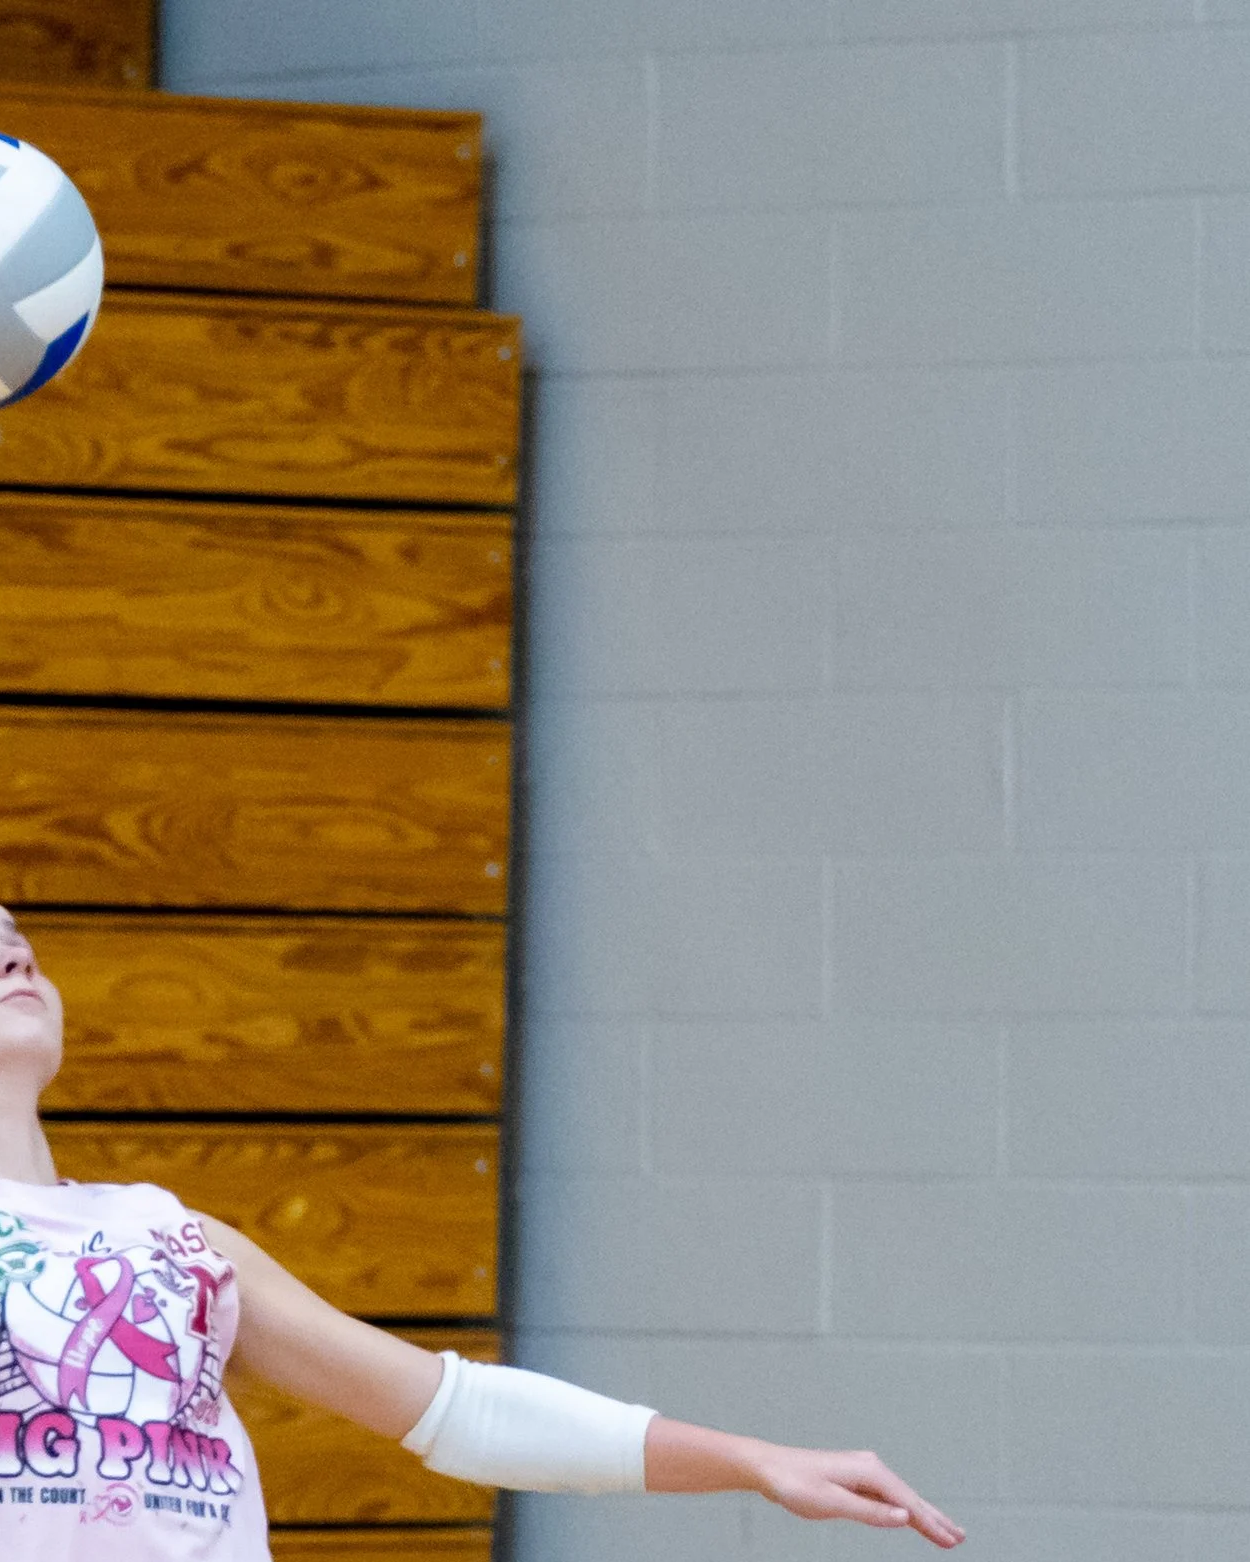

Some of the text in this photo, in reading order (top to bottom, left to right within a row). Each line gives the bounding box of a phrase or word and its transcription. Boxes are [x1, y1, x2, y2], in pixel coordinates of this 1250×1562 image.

[96, 1414, 243, 1496] PINK
[10, 1487, 34, 1504] THE
[40, 1487, 86, 1504] COURT
